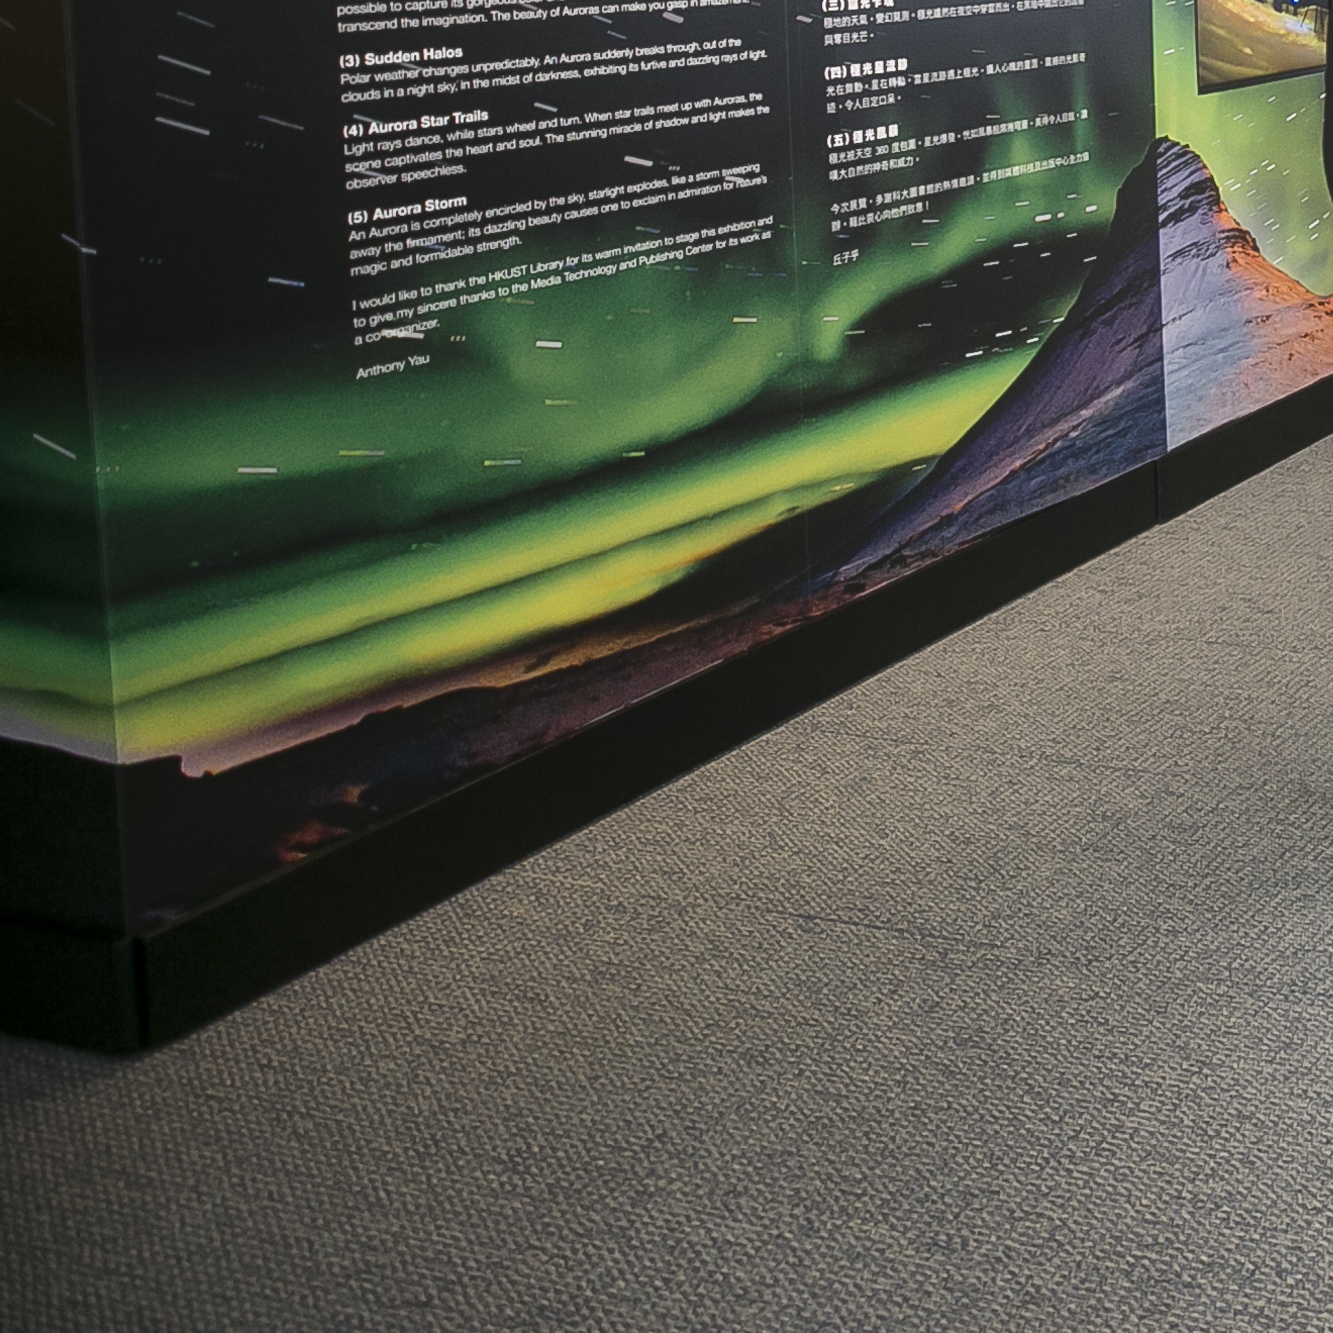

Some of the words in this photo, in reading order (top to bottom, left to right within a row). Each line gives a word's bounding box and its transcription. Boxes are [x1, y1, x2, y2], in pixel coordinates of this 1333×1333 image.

[340, 54, 360, 68] (3)
[365, 51, 420, 64] Sudden
[423, 47, 463, 60] Halos
[344, 124, 363, 138] (4)
[369, 120, 417, 134] Aurora
[421, 116, 450, 128] Star
[453, 110, 488, 124] Trails
[346, 174, 398, 189] observer
[348, 211, 368, 225] (5)
[373, 204, 421, 220] Aurora
[425, 197, 467, 211] Storm
[351, 262, 387, 276] magic
[391, 255, 413, 269] and
[416, 245, 474, 263] formidable
[359, 293, 395, 309] would
[398, 290, 417, 300] like
[435, 279, 466, 293] thank
[469, 276, 486, 286] the
[489, 265, 527, 282] HKUST
[530, 260, 564, 273] Library
[595, 248, 621, 259] warm
[624, 240, 663, 253] invitation
[676, 232, 699, 243] stage
[701, 229, 716, 238] this
[718, 221, 757, 234] exhibition
[757, 215, 773, 226] and
[356, 361, 405, 379] Anthony
[408, 355, 430, 366] Yau
